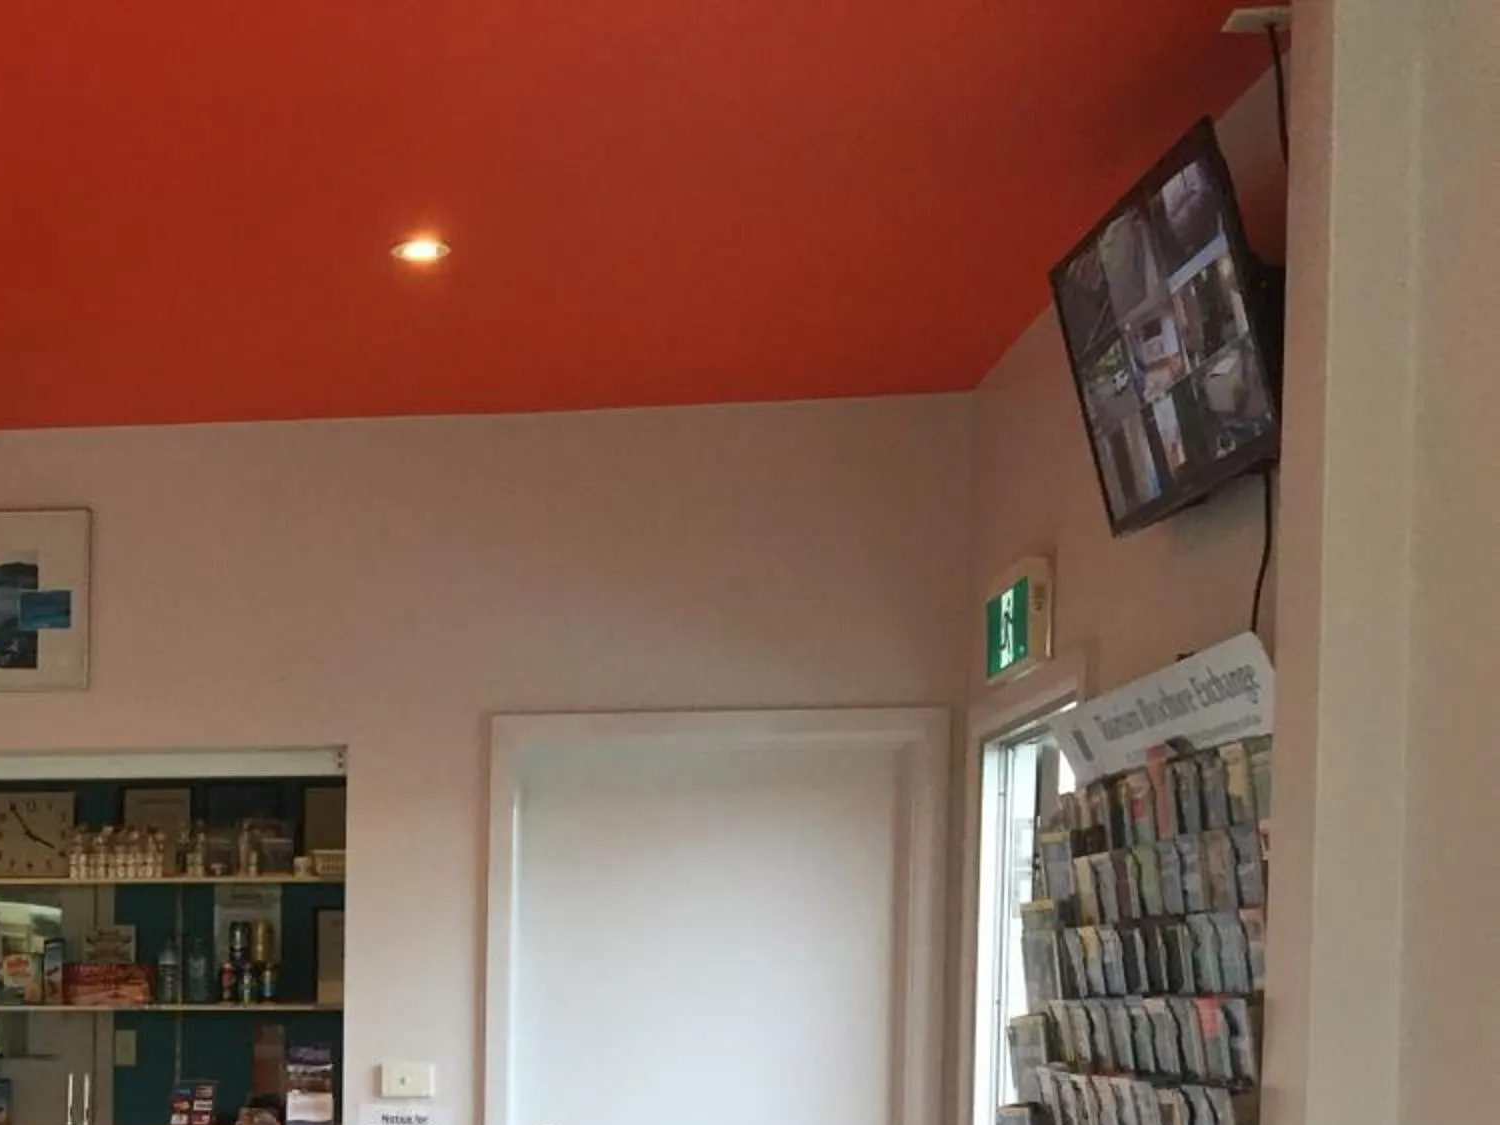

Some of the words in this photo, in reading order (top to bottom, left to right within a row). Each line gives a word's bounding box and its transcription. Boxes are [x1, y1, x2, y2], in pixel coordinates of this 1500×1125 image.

[1137, 684, 1199, 728] Brochure
[1189, 664, 1261, 707] Exchange
[382, 1113, 414, 1125] Notice
